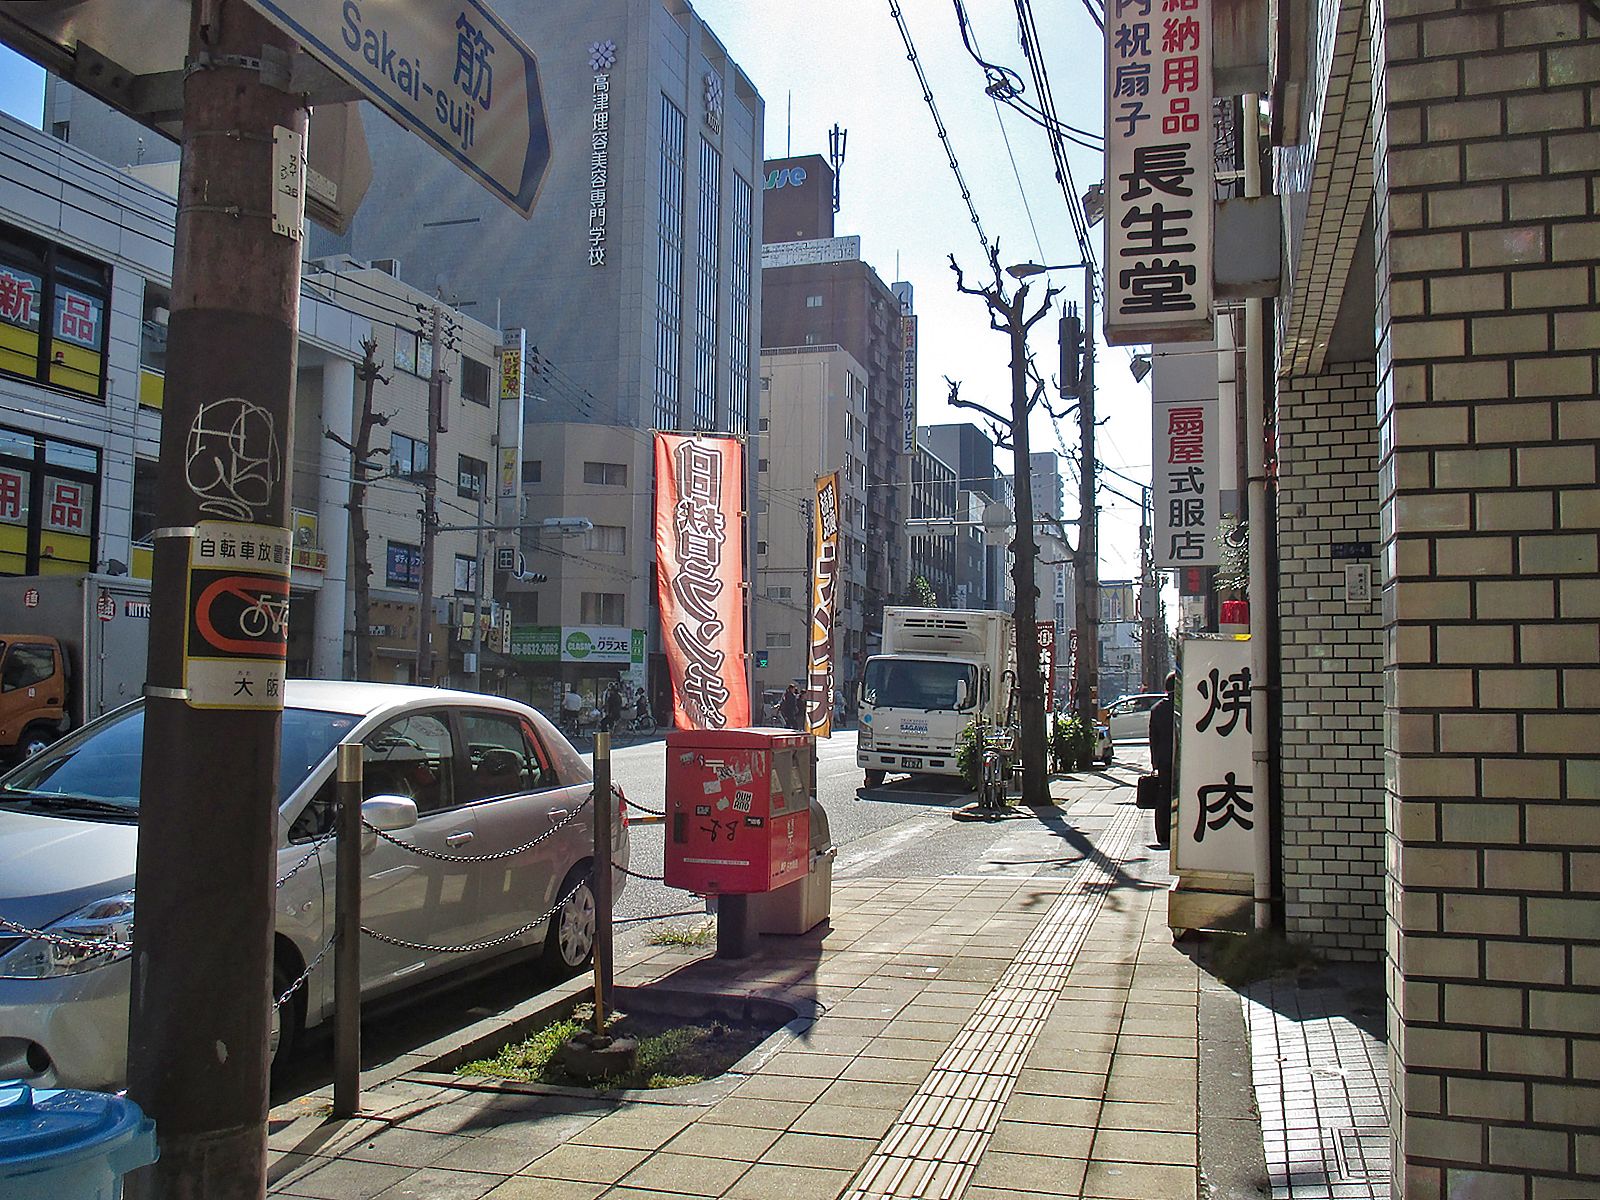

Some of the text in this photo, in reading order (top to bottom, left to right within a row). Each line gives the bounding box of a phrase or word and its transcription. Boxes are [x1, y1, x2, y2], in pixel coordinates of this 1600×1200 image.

[342, 0, 475, 151] Sakai-suji
[453, 12, 494, 111] 筋
[588, 73, 610, 266] 高津理容美容専門学校
[1118, 142, 1197, 315] 長生堂
[904, 349, 914, 450] 富士ホームサービス
[1168, 407, 1206, 560] 扇屋式服店
[233, 677, 285, 697] 大阪
[598, 640, 628, 651] クラスモ
[1193, 667, 1253, 843] 焼肉
